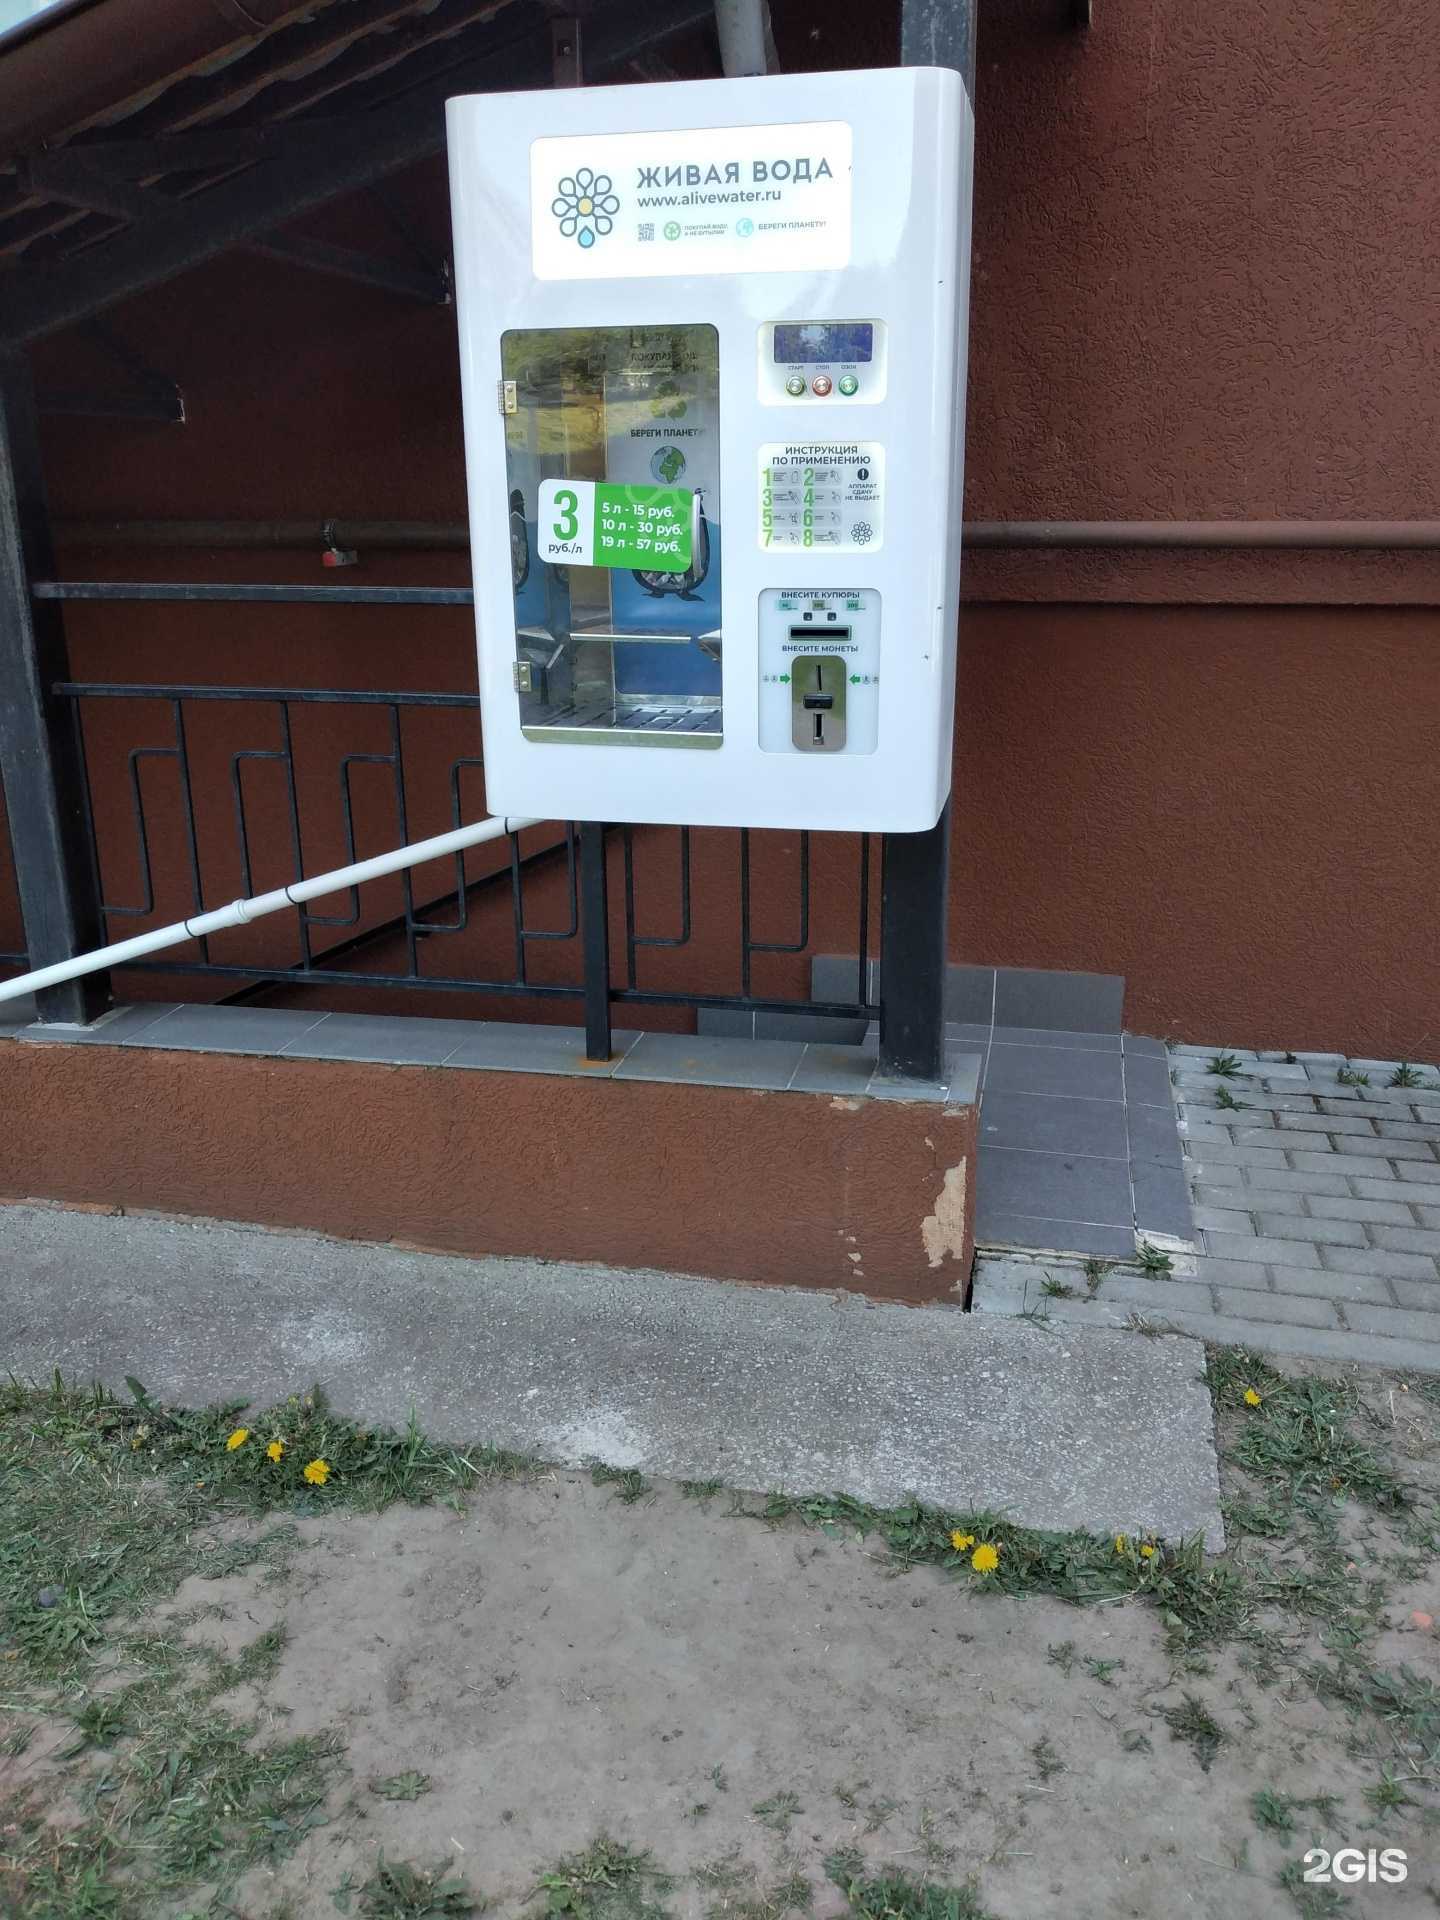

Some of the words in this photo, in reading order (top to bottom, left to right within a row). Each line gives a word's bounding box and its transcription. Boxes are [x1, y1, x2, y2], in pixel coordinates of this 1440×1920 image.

[637, 163, 740, 189] ЖИВАЯ
[752, 158, 834, 184] ВОДА
[637, 190, 783, 208] www.alivewater.ru
[758, 222, 787, 231] БЕРЕГИ
[631, 429, 662, 438] БЕРЕГИ
[785, 446, 858, 455] ИНСТРУКЦИЯ
[772, 457, 788, 465] ПО
[791, 456, 871, 465] ПРИМЕНЕНИЮ
[762, 467, 772, 486] 1
[803, 467, 814, 486] 2
[762, 488, 773, 507] 3
[803, 488, 815, 508] 4
[553, 490, 578, 541] 3
[602, 502, 610, 513] 5
[612, 504, 622, 514] л
[632, 504, 645, 516] 15
[648, 506, 675, 519] руб.
[762, 508, 773, 528] 5
[803, 508, 814, 528] 6
[601, 519, 615, 530] 10
[618, 522, 627, 531] л
[637, 522, 653, 533] 30
[656, 523, 683, 536] руб.
[601, 535, 614, 547] 19
[616, 539, 625, 548] л
[636, 538, 651, 550] 57
[655, 540, 681, 553] руб.
[762, 529, 774, 548] 7
[803, 529, 814, 548] 8
[548, 543, 583, 554] руб./л
[781, 591, 819, 599] ВНЕСИТЕ
[821, 591, 860, 599] КУПЮРЫ
[821, 645, 858, 653] МОНЕТЫ
